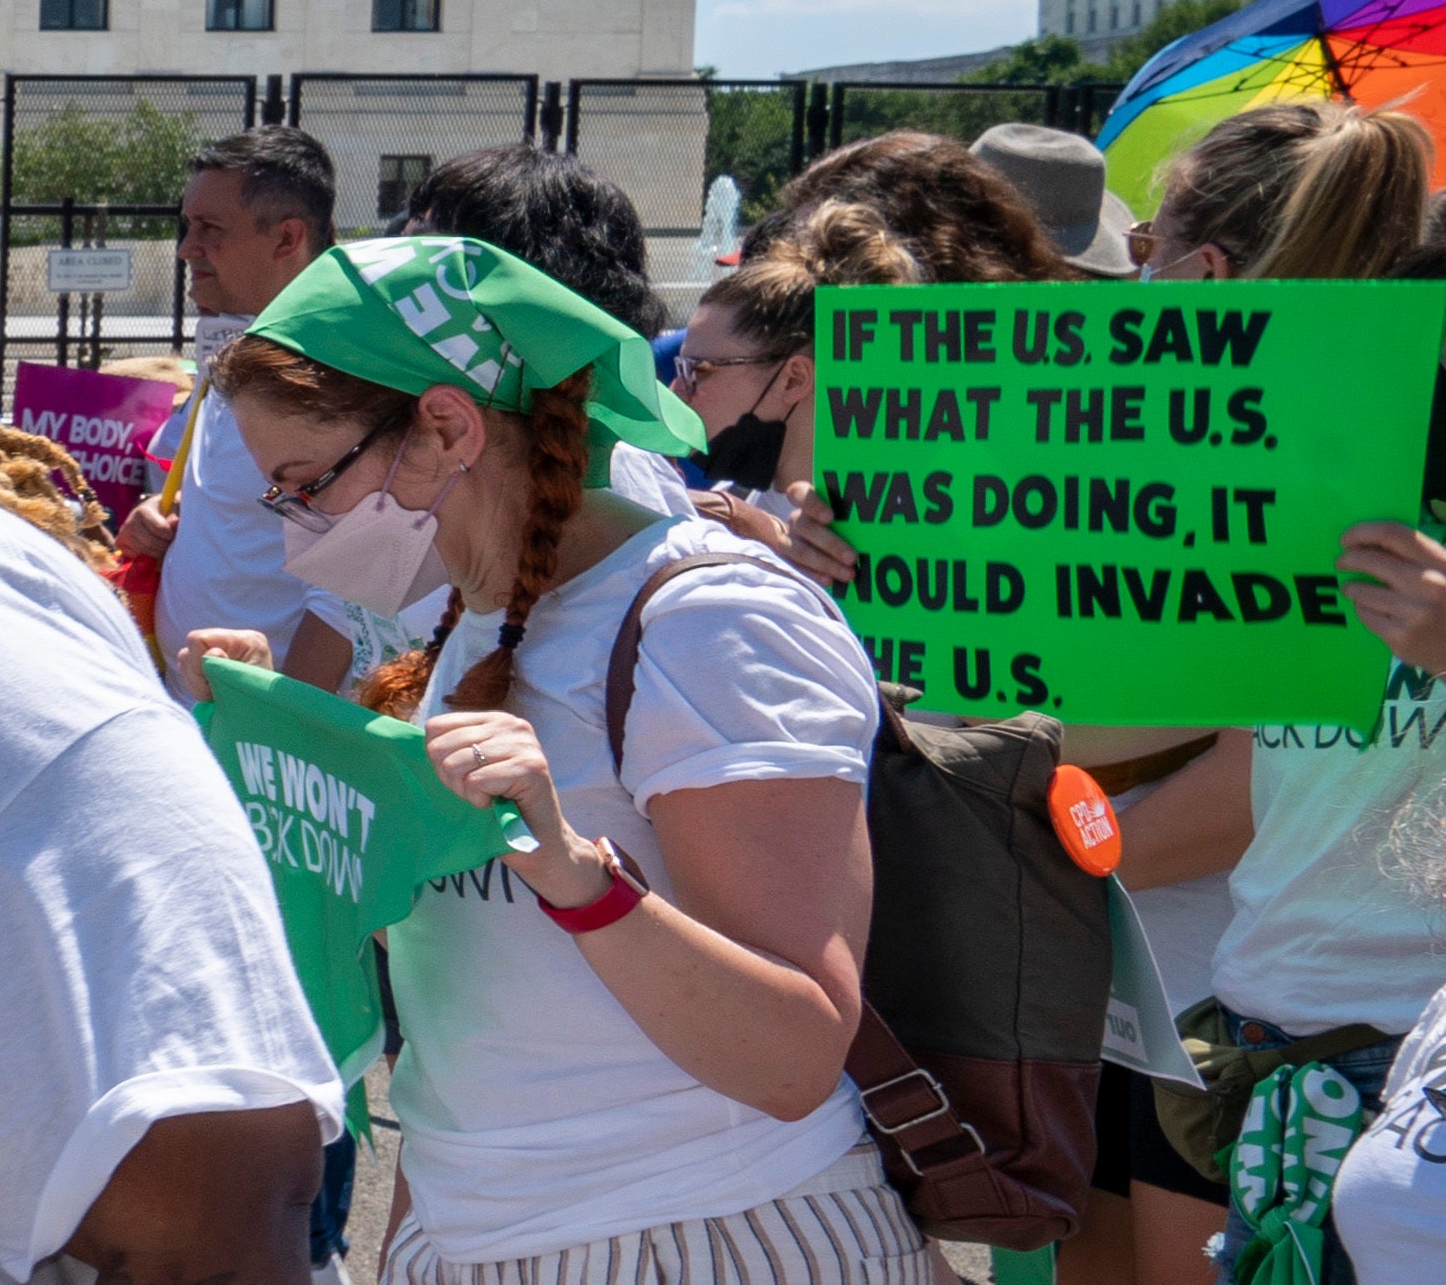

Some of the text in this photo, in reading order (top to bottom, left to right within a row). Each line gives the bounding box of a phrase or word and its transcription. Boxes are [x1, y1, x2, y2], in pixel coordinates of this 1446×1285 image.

[832, 308, 1273, 367] IF THE U.S. SAW
[22, 408, 134, 455] MY BODY,
[826, 386, 1278, 451] WHAT THE U.S.
[822, 470, 1277, 548] WAS DOING, IT
[1056, 563, 1348, 628] INVADE
[857, 634, 1063, 709] HE U.S.
[235, 741, 376, 854] WE WON'T
[1069, 800, 1093, 828] CPD
[1079, 815, 1115, 850] ACTION
